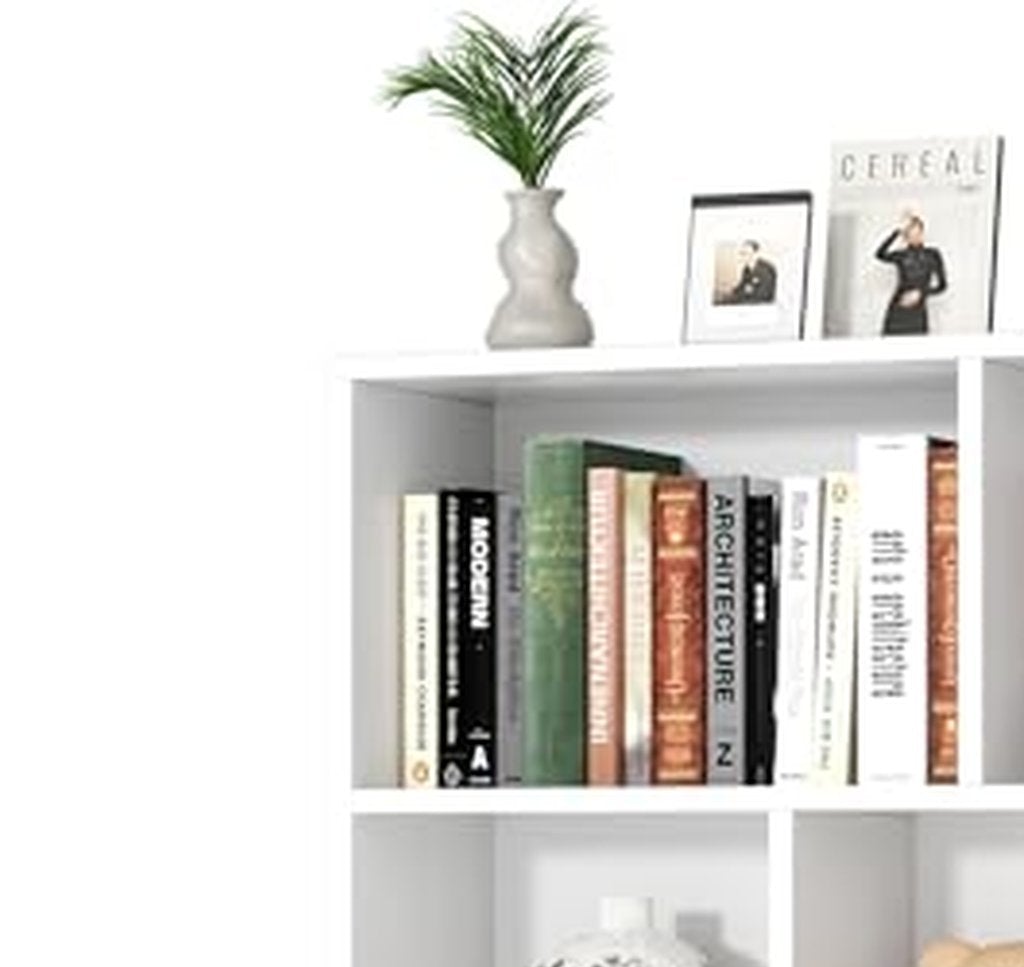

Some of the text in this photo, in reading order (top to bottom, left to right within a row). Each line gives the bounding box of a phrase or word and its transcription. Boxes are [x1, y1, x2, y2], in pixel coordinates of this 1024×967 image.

[841, 149, 986, 180] CEREAL
[471, 516, 490, 630] MODERN
[713, 494, 735, 704] ARCHITECTURE
